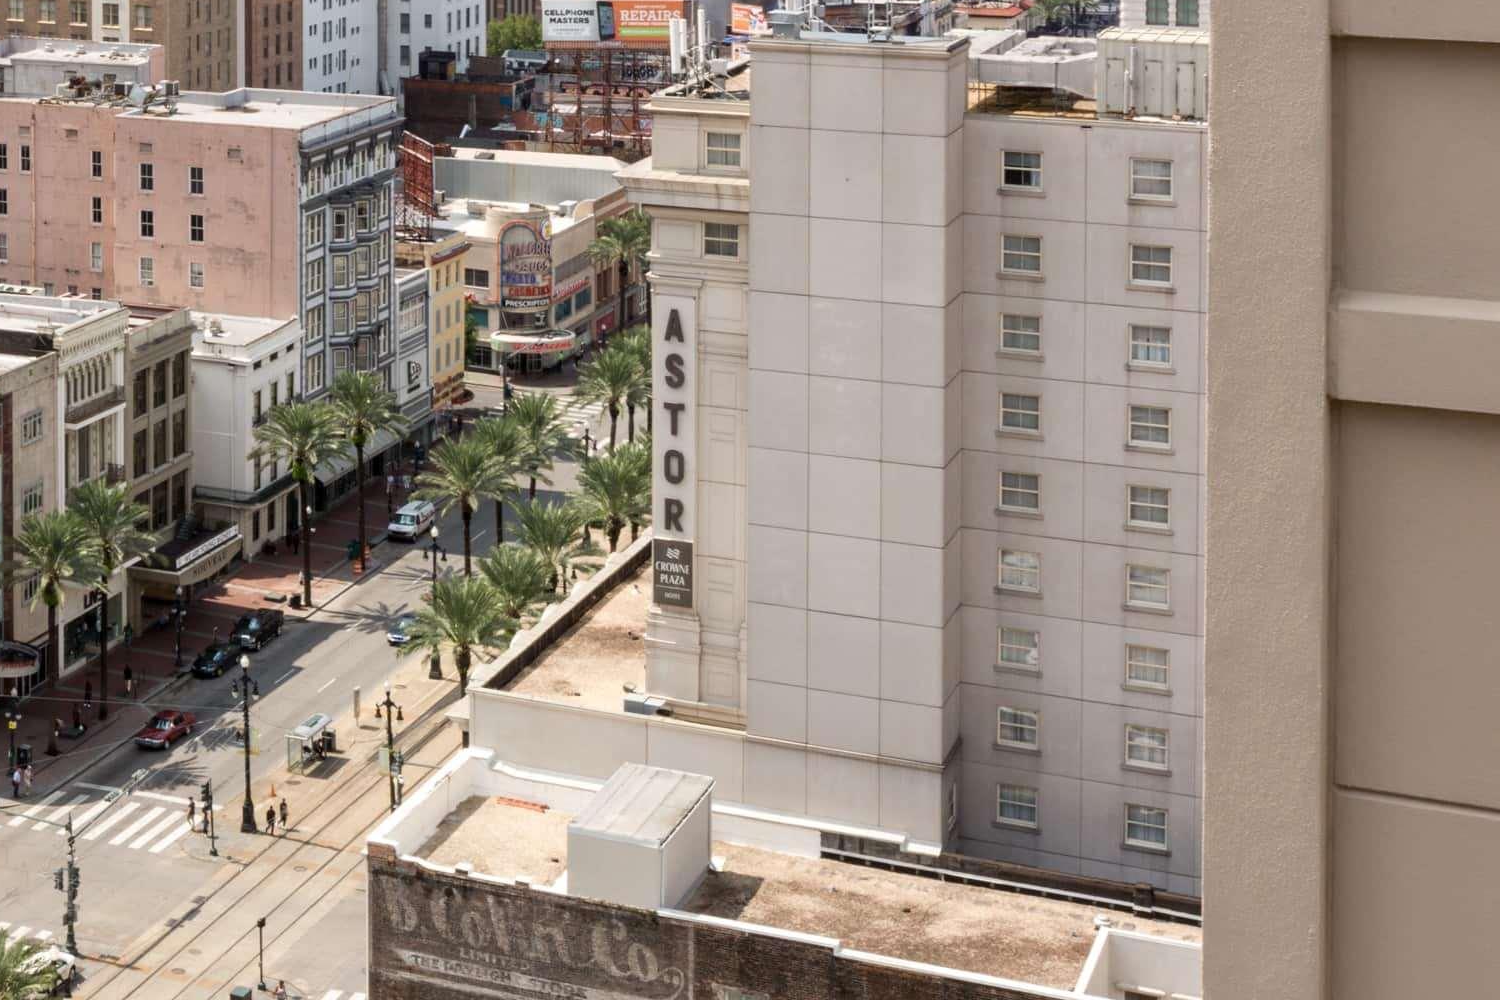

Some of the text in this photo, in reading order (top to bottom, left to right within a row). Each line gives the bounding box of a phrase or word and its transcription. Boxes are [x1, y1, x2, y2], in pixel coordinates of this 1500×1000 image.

[550, 16, 590, 24] MASTERS
[620, 9, 680, 21] REPAIRS
[663, 309, 685, 533] ASTOR
[655, 561, 689, 575] CROWNE
[660, 573, 685, 586] PLAZA
[411, 954, 441, 970] THE
[460, 948, 531, 970] LIMITED
